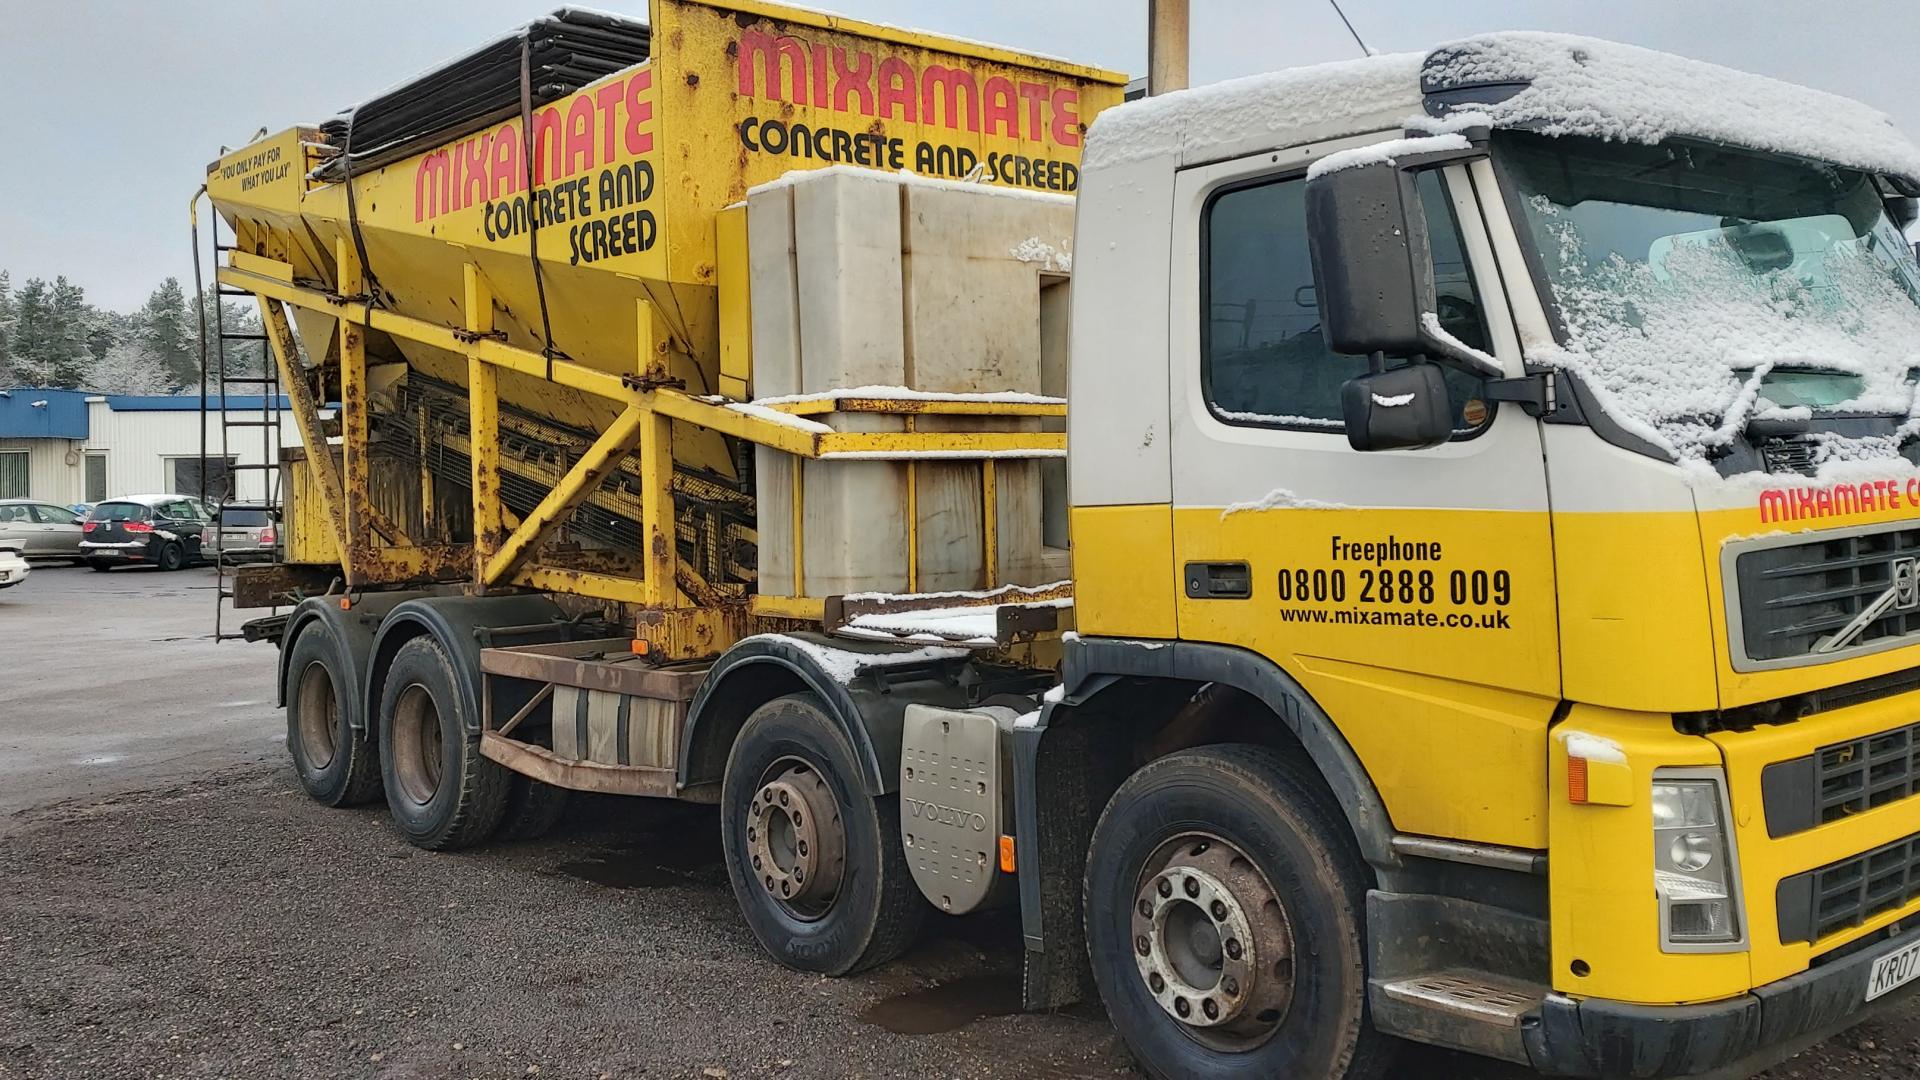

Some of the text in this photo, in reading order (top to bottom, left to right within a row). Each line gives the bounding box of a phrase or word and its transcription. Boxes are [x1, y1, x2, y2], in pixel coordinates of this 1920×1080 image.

[738, 29, 1079, 147] MIXAMATE
[236, 157, 252, 176] ONLY
[253, 152, 266, 169] PAY
[267, 147, 280, 164] FOR
[416, 69, 654, 224] MIXAMATE
[741, 117, 1079, 191] CONCRETE AND SCREED
[241, 173, 260, 192] WHAT
[261, 169, 275, 185] YOU
[484, 160, 654, 242] CONCRETE AND
[570, 210, 656, 266] SCREED
[1759, 479, 1900, 524] MIXAMATE
[1332, 535, 1442, 567] Freephone
[1278, 568, 1511, 606] 0800 2888 009
[1280, 607, 1511, 629] www.mixamate.co.uk
[905, 797, 986, 832] VOLVO
[1874, 946, 1920, 993] KR07
